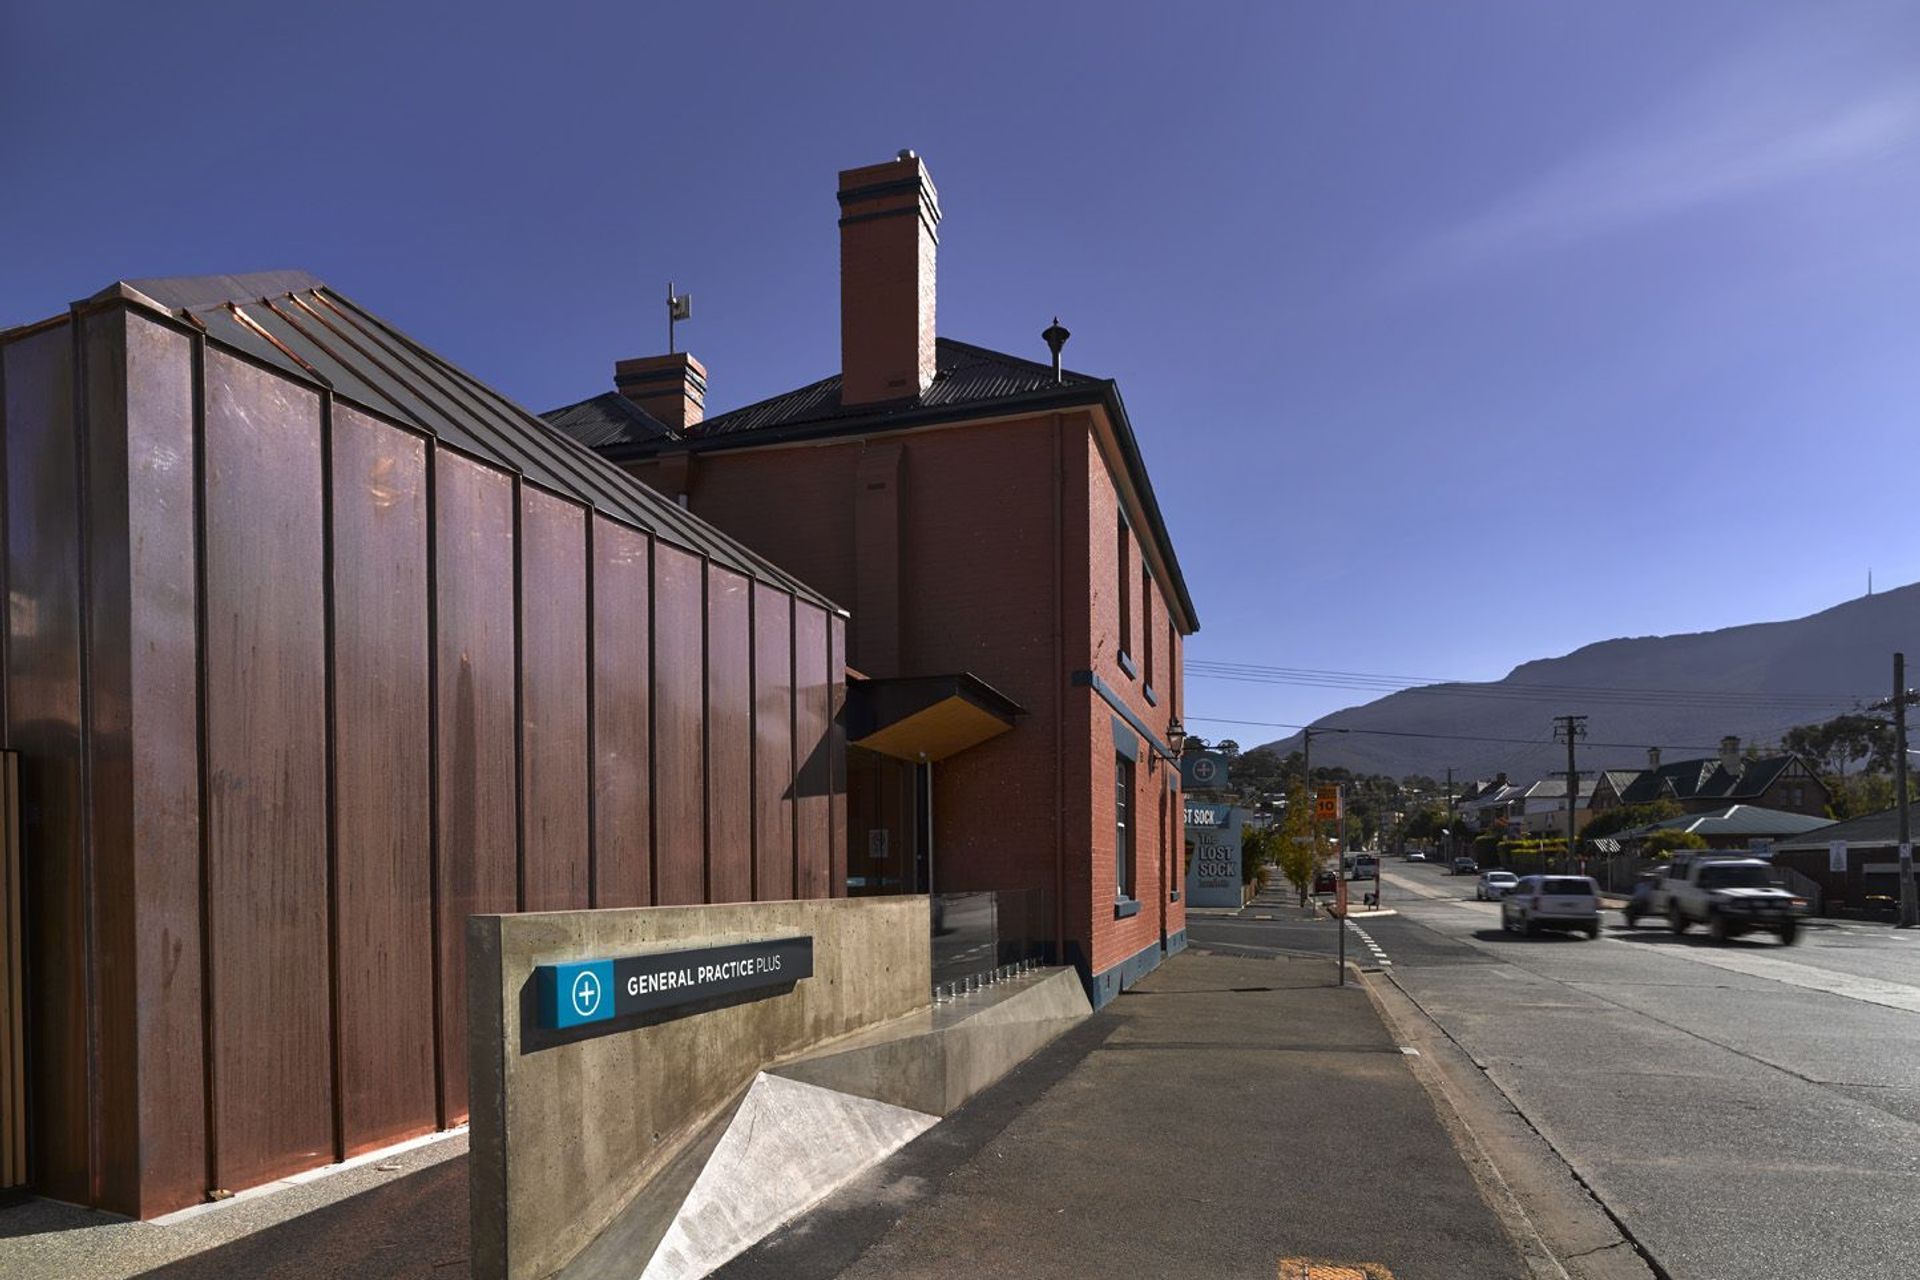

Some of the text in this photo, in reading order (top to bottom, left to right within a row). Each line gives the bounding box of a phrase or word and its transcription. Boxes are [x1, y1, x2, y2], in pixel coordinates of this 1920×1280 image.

[1194, 809, 1215, 825] SOCK
[1200, 846, 1232, 860] LOST
[1199, 862, 1235, 877] SOCK
[627, 954, 781, 997] GENERAL PRACTICE PLUS
